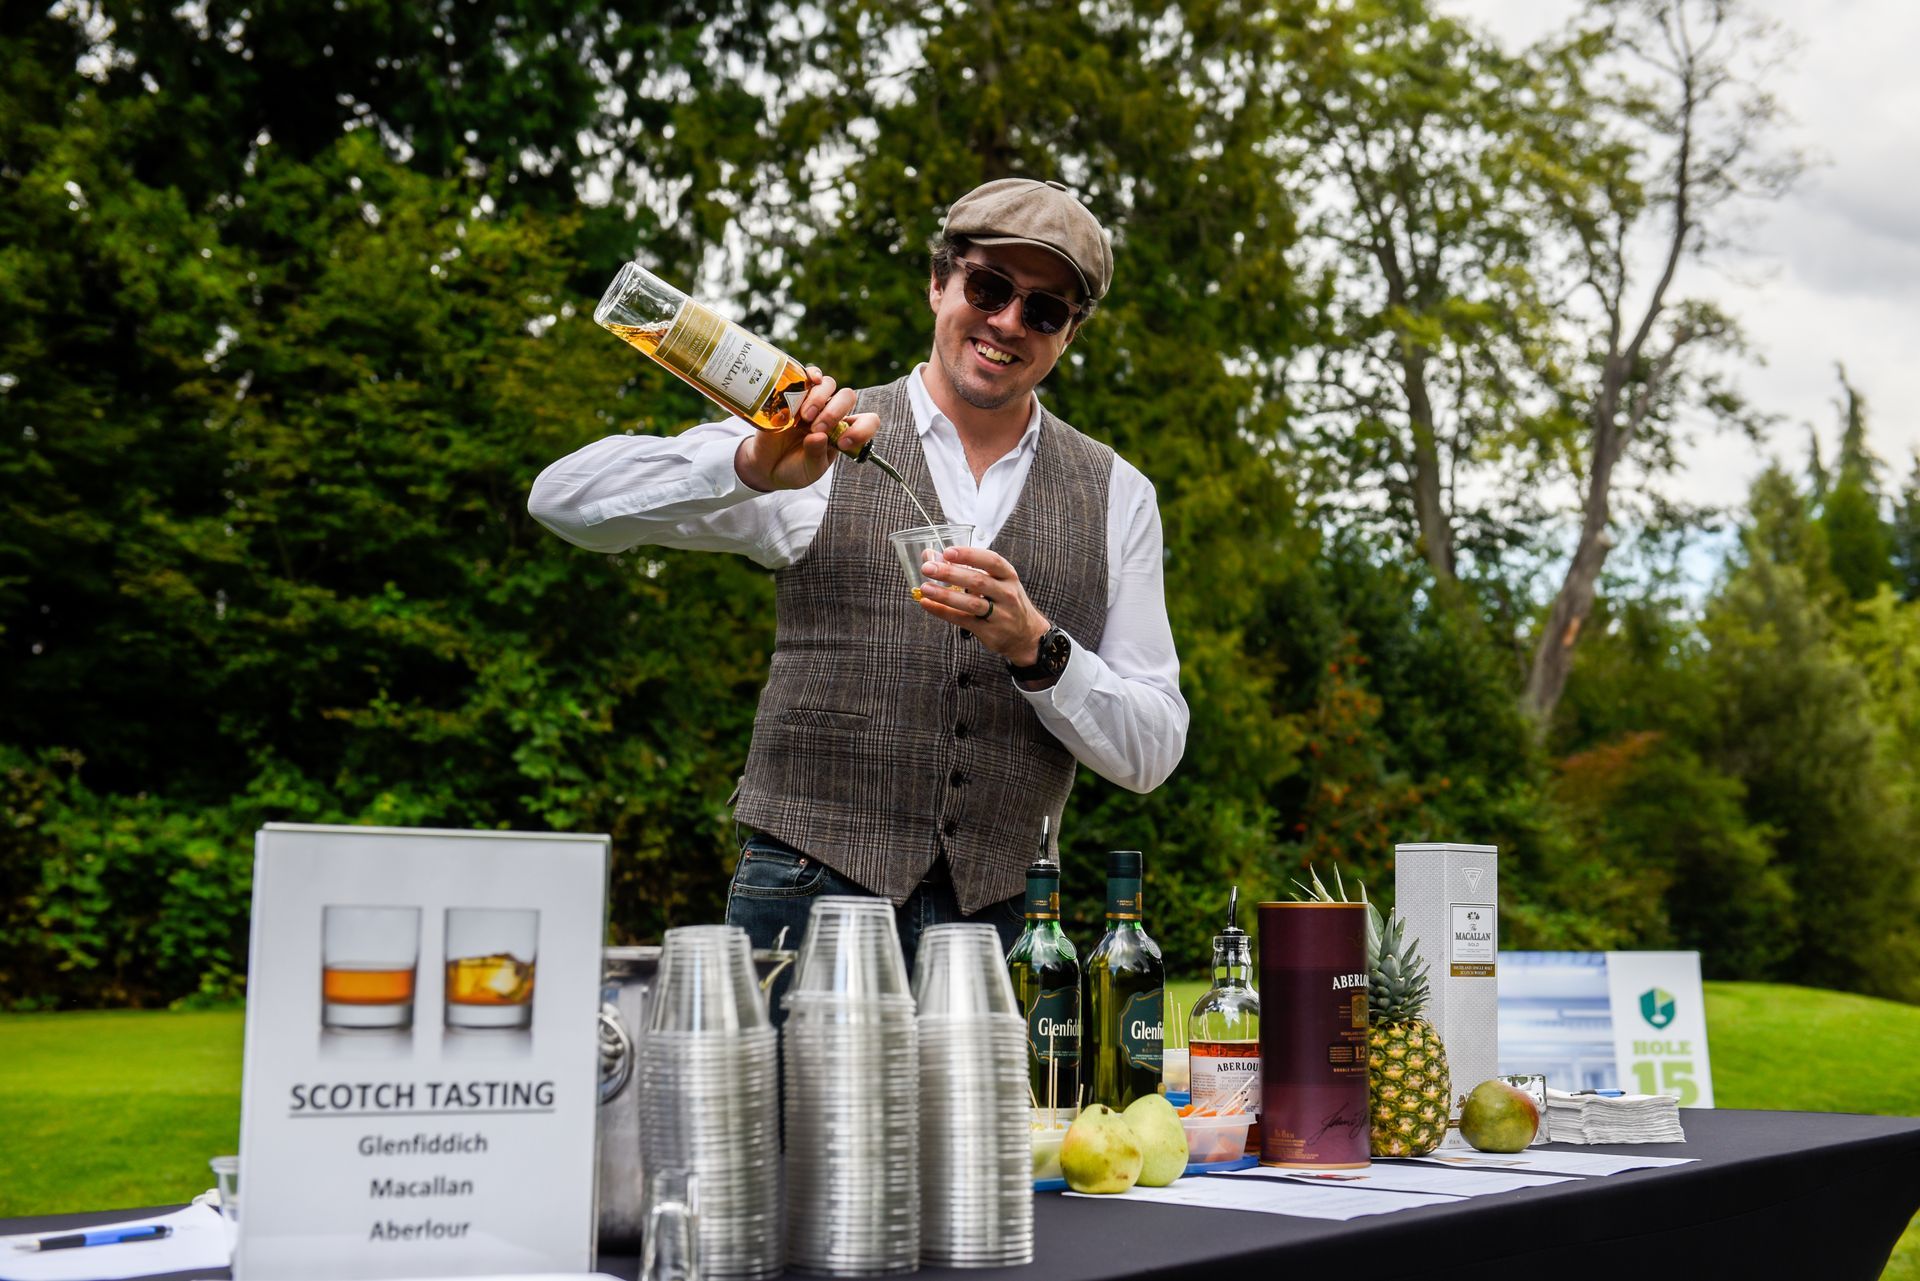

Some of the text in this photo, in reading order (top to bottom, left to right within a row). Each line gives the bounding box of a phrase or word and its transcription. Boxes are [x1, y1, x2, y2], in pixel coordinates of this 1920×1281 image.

[721, 341, 752, 388] MACALLAN
[1456, 933, 1491, 941] MACALLAN
[1355, 1045, 1366, 1059] 12
[1632, 1041, 1693, 1056] HOLE
[1217, 1062, 1259, 1073] ABERLOU
[1631, 1060, 1700, 1107] 15
[290, 1081, 556, 1111] SCOTCH TASTING
[357, 1132, 489, 1157] Glenfiddich
[369, 1176, 474, 1199] Macallan
[368, 1218, 471, 1242] Aberlour
